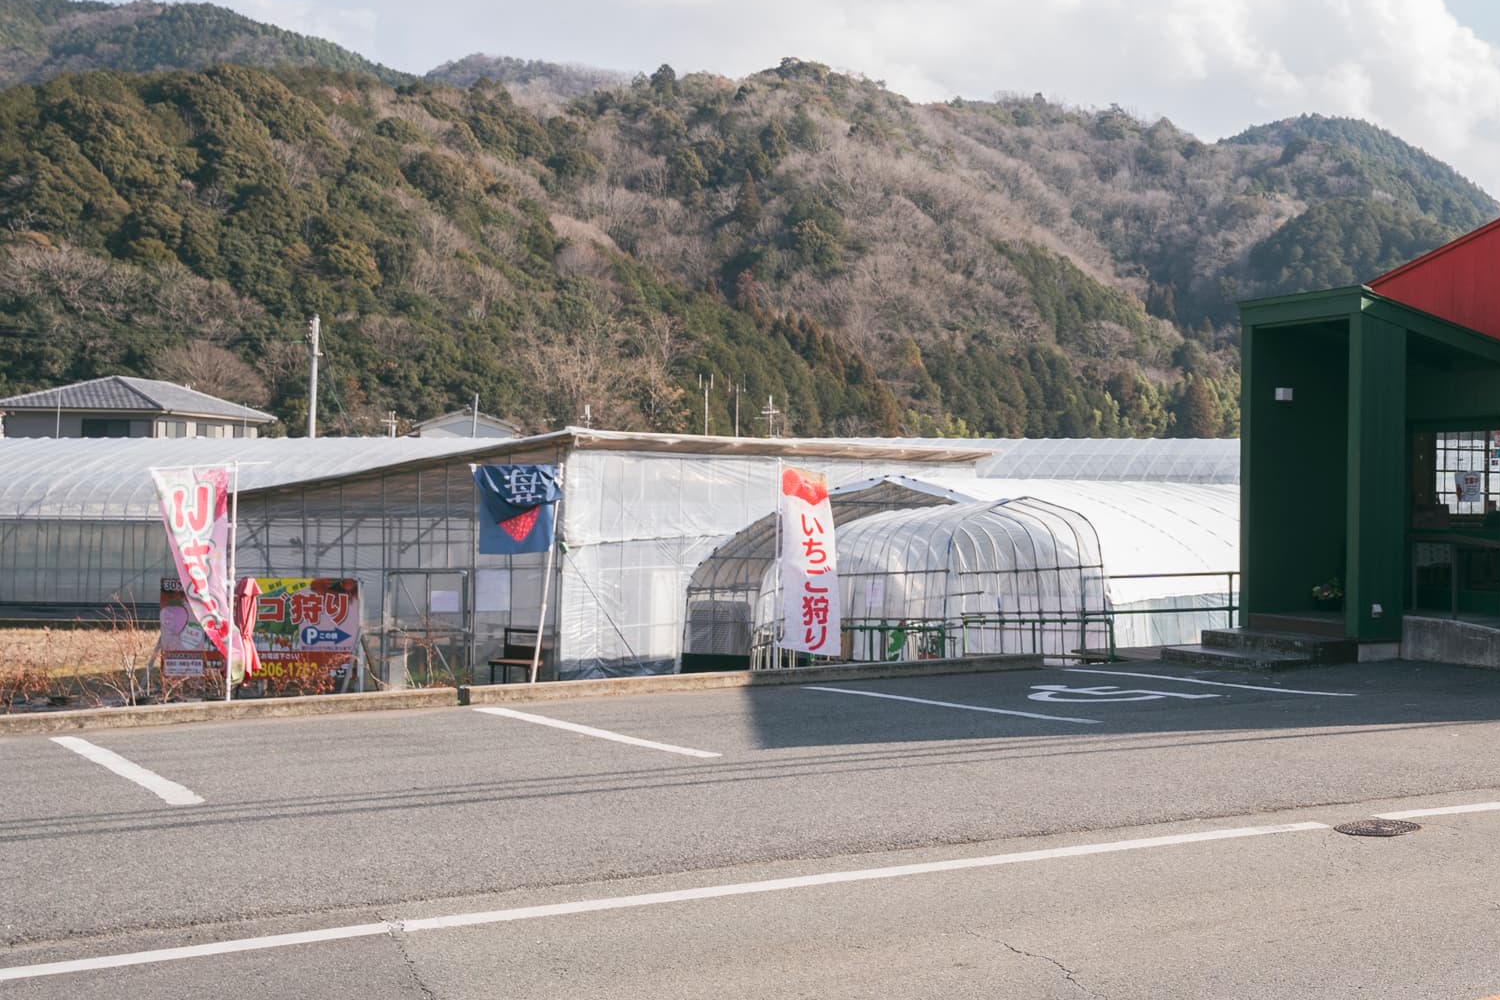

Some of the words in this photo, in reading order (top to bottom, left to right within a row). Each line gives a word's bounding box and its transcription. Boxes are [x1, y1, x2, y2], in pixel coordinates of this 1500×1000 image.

[802, 513, 831, 651] いちご狩り
[252, 591, 349, 625] ゴ狩り
[306, 629, 317, 644] P
